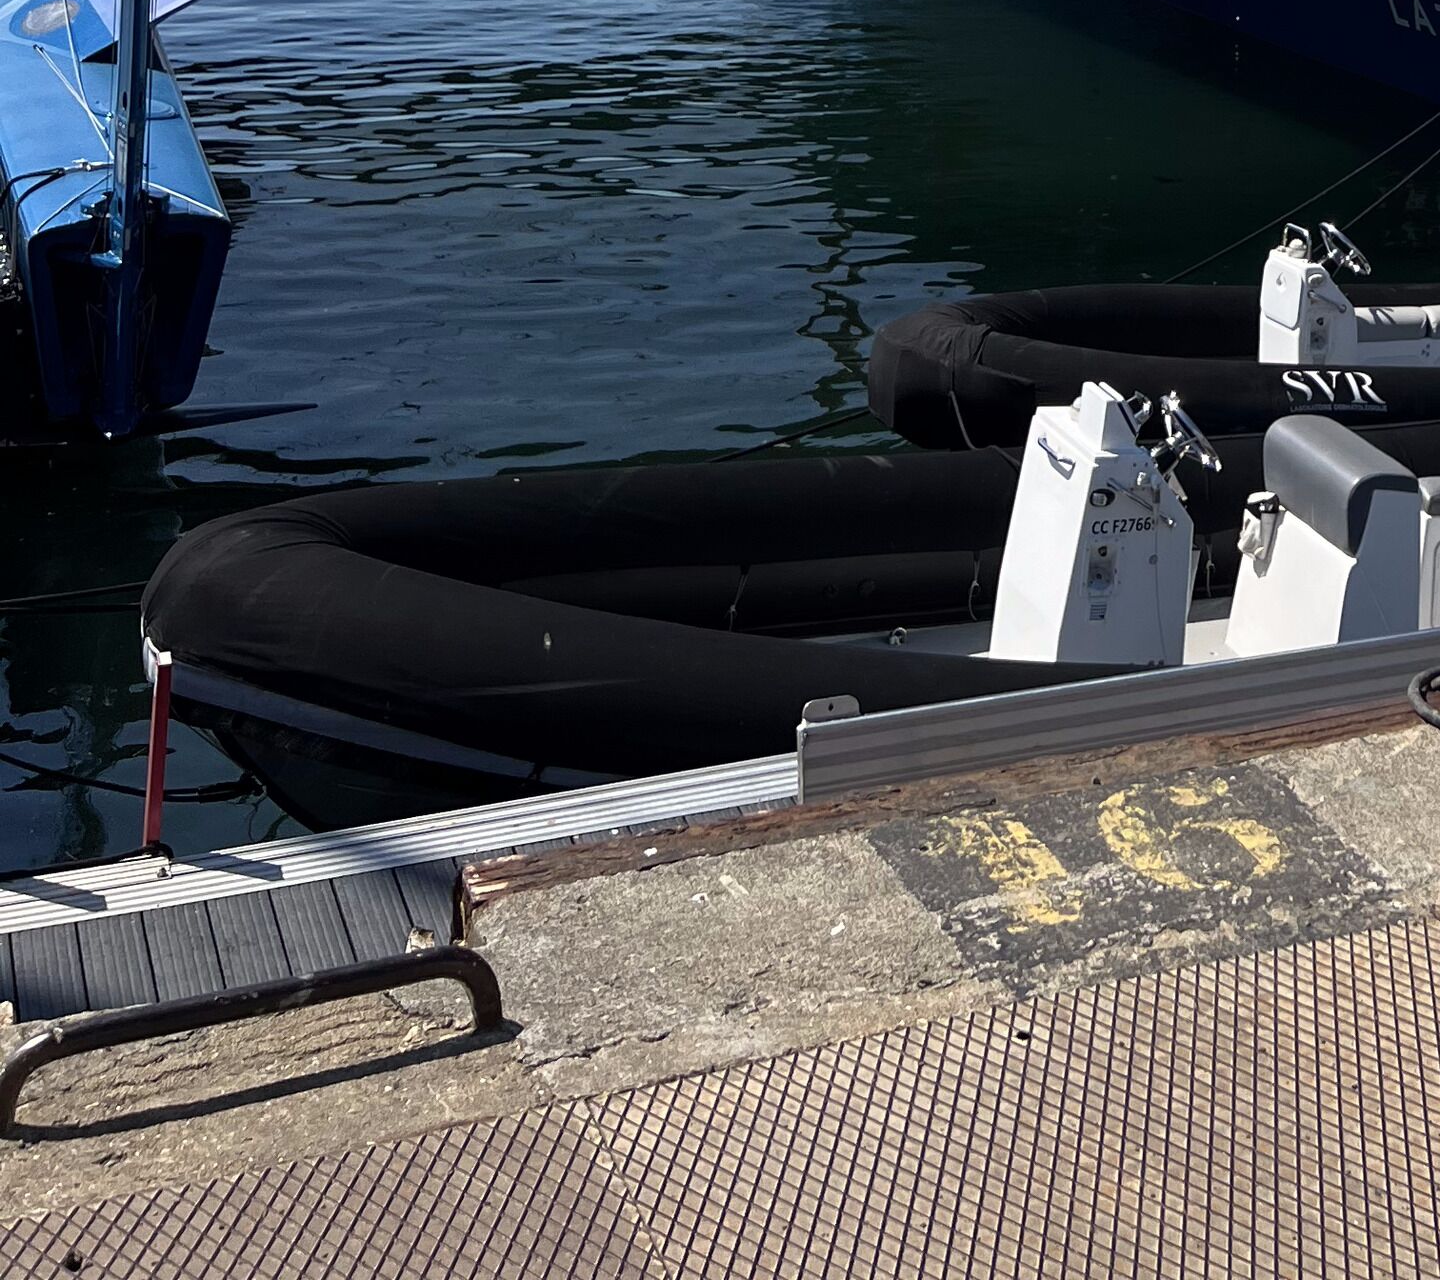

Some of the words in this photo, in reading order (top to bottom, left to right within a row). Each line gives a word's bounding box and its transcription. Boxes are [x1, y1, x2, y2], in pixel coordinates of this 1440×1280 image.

[1282, 370, 1386, 404] SVR
[1091, 520, 1109, 534] CC
[926, 776, 1288, 933] 16
